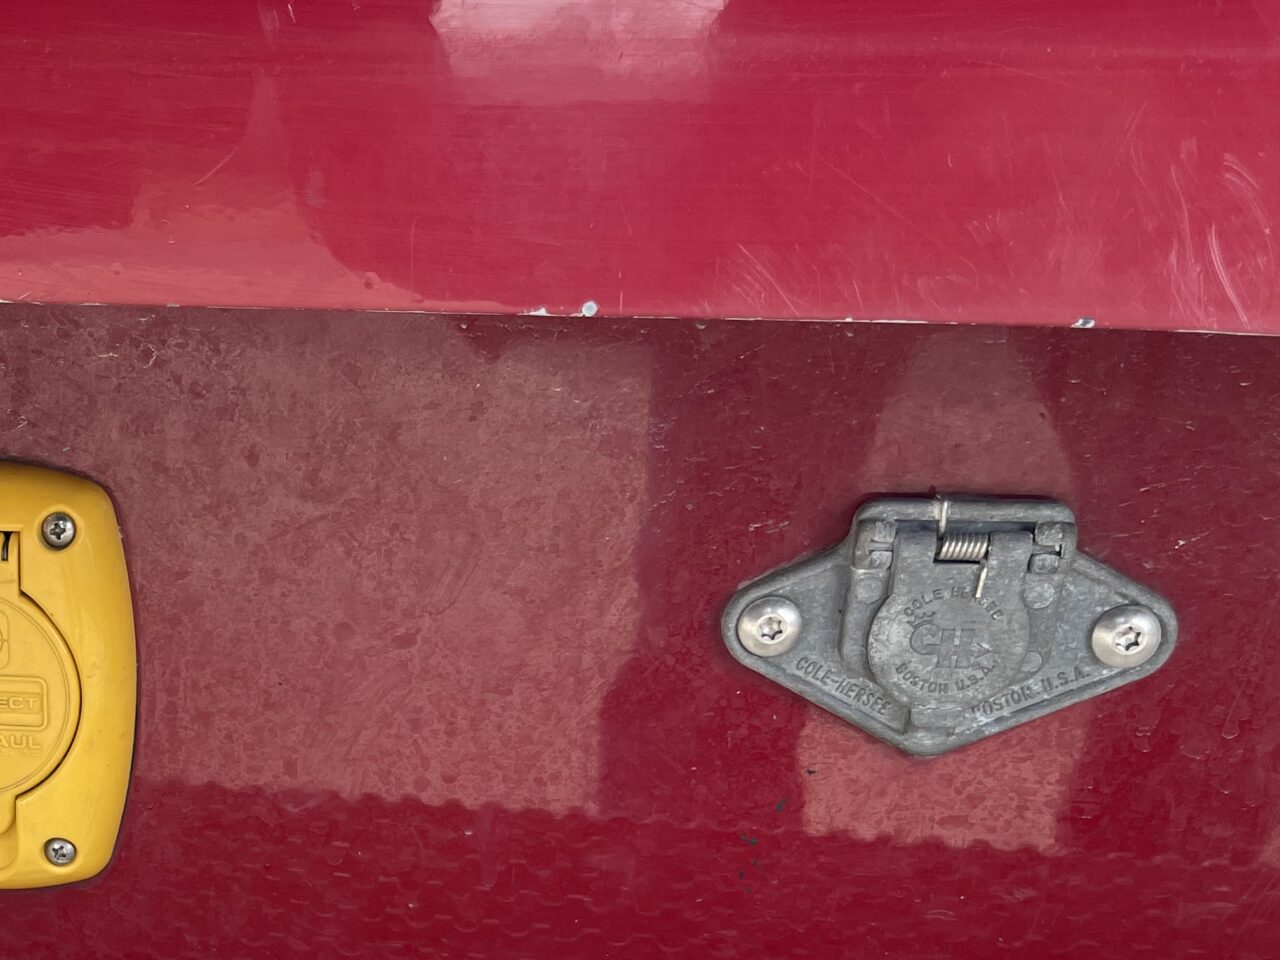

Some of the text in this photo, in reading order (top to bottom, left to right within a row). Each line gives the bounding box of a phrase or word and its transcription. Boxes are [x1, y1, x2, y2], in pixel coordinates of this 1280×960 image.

[903, 588, 944, 617] COLE
[794, 656, 892, 717] COLE-HERSEE
[895, 662, 949, 695] BOSTON
